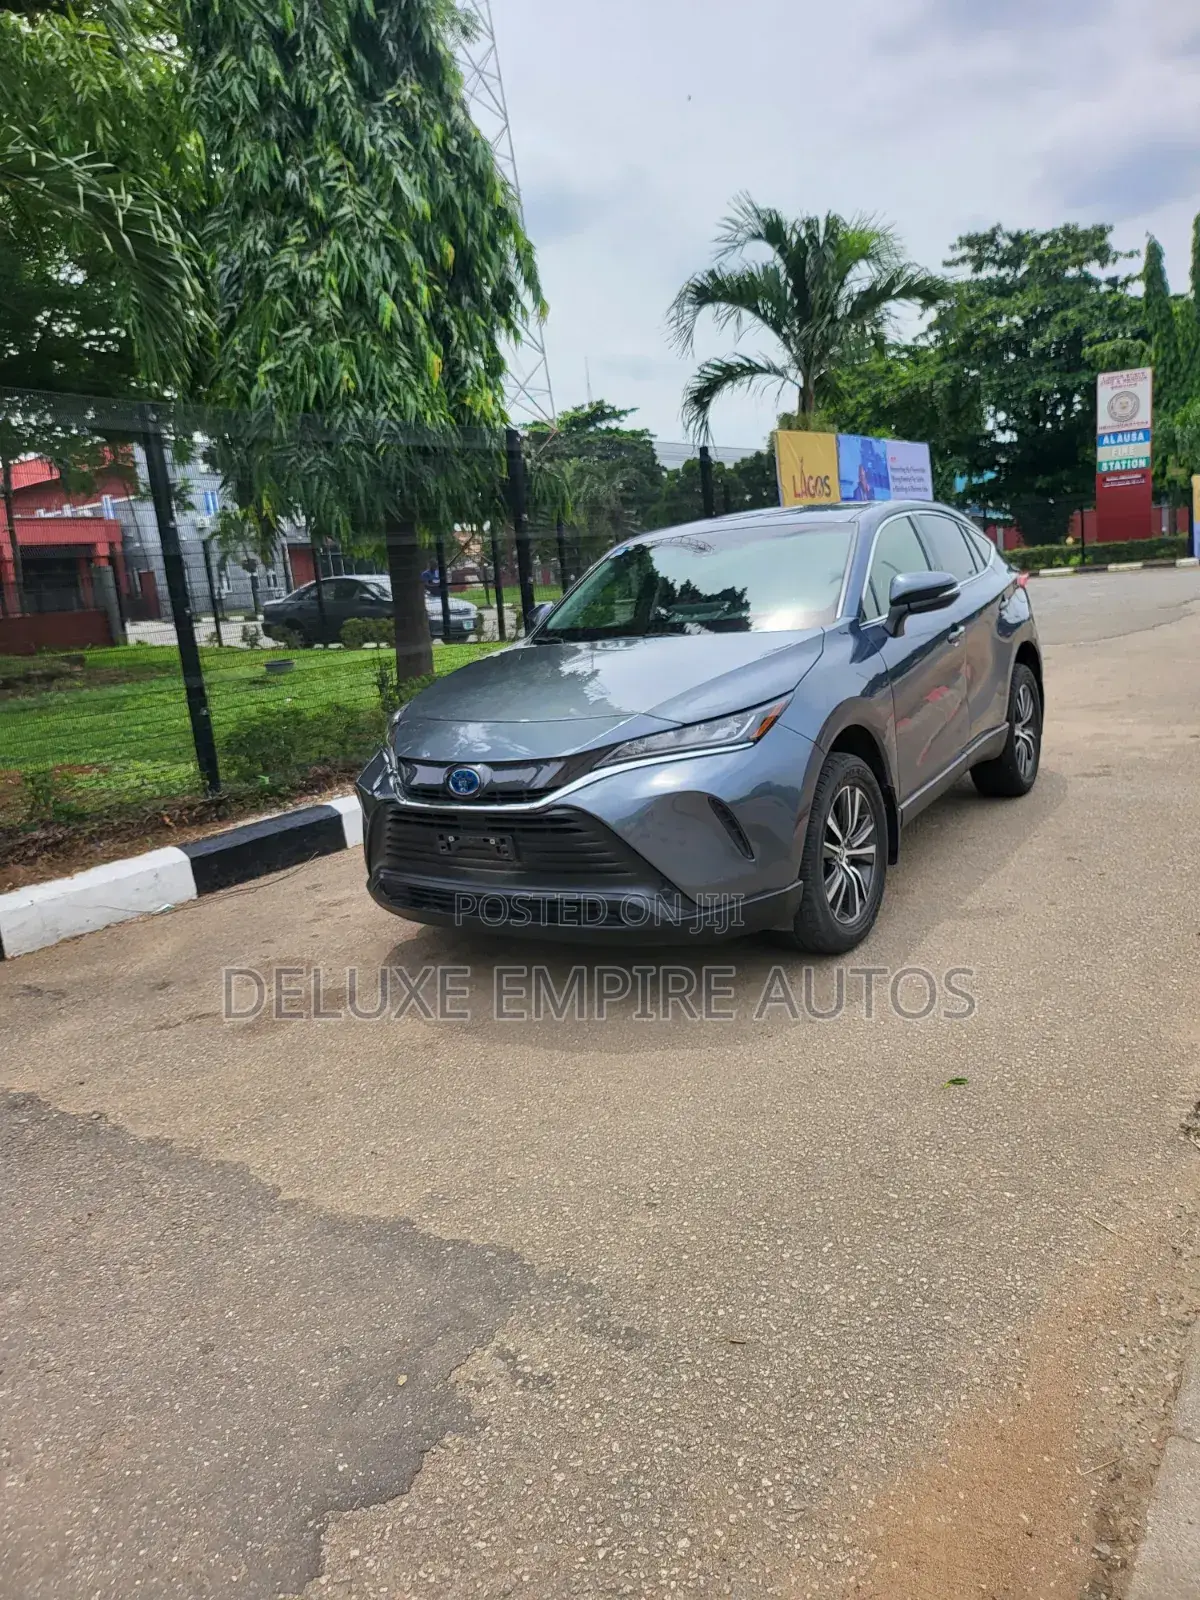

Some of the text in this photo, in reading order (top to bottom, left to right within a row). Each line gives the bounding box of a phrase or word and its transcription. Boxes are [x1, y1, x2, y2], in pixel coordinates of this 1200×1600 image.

[1103, 431, 1145, 445] ALAUSA
[1101, 458, 1147, 471] STATION
[792, 457, 831, 498] LAGOS
